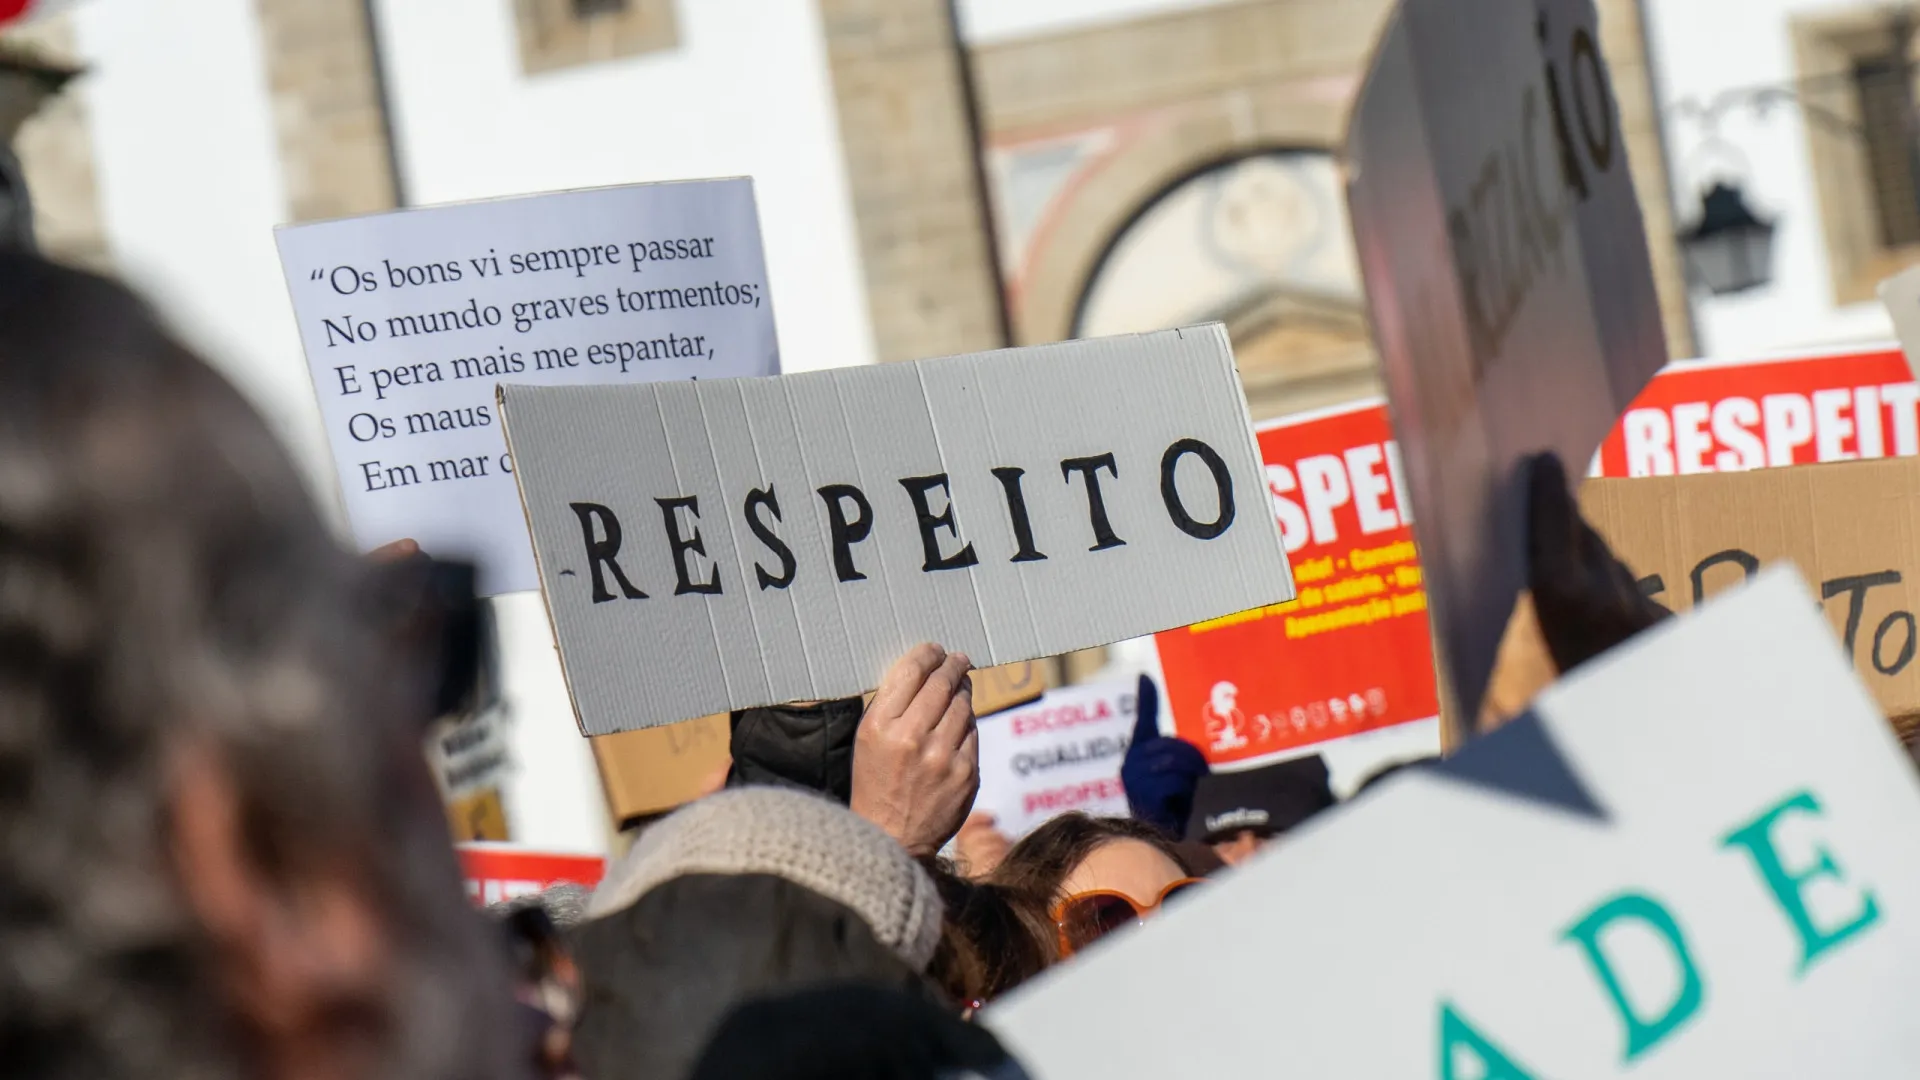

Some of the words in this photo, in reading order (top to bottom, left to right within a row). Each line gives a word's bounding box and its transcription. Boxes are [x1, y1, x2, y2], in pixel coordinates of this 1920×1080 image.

[382, 259, 463, 288] bons
[469, 248, 503, 278] vi
[509, 242, 621, 277] sempre
[627, 236, 714, 273] passar
[321, 315, 377, 347] No
[386, 298, 501, 338] mundo
[511, 293, 610, 333] graves
[616, 280, 761, 313] tormentos;
[334, 365, 362, 396] E
[369, 361, 444, 400] pera
[450, 345, 526, 379] mais
[533, 346, 579, 371] me
[587, 332, 714, 373] espantar,
[348, 412, 397, 442] Os
[404, 405, 491, 435] maus
[359, 460, 421, 492] Em
[427, 455, 489, 482] mar
[570, 438, 1234, 603] RESPEITO
[1012, 700, 1111, 735] ESCOLA
